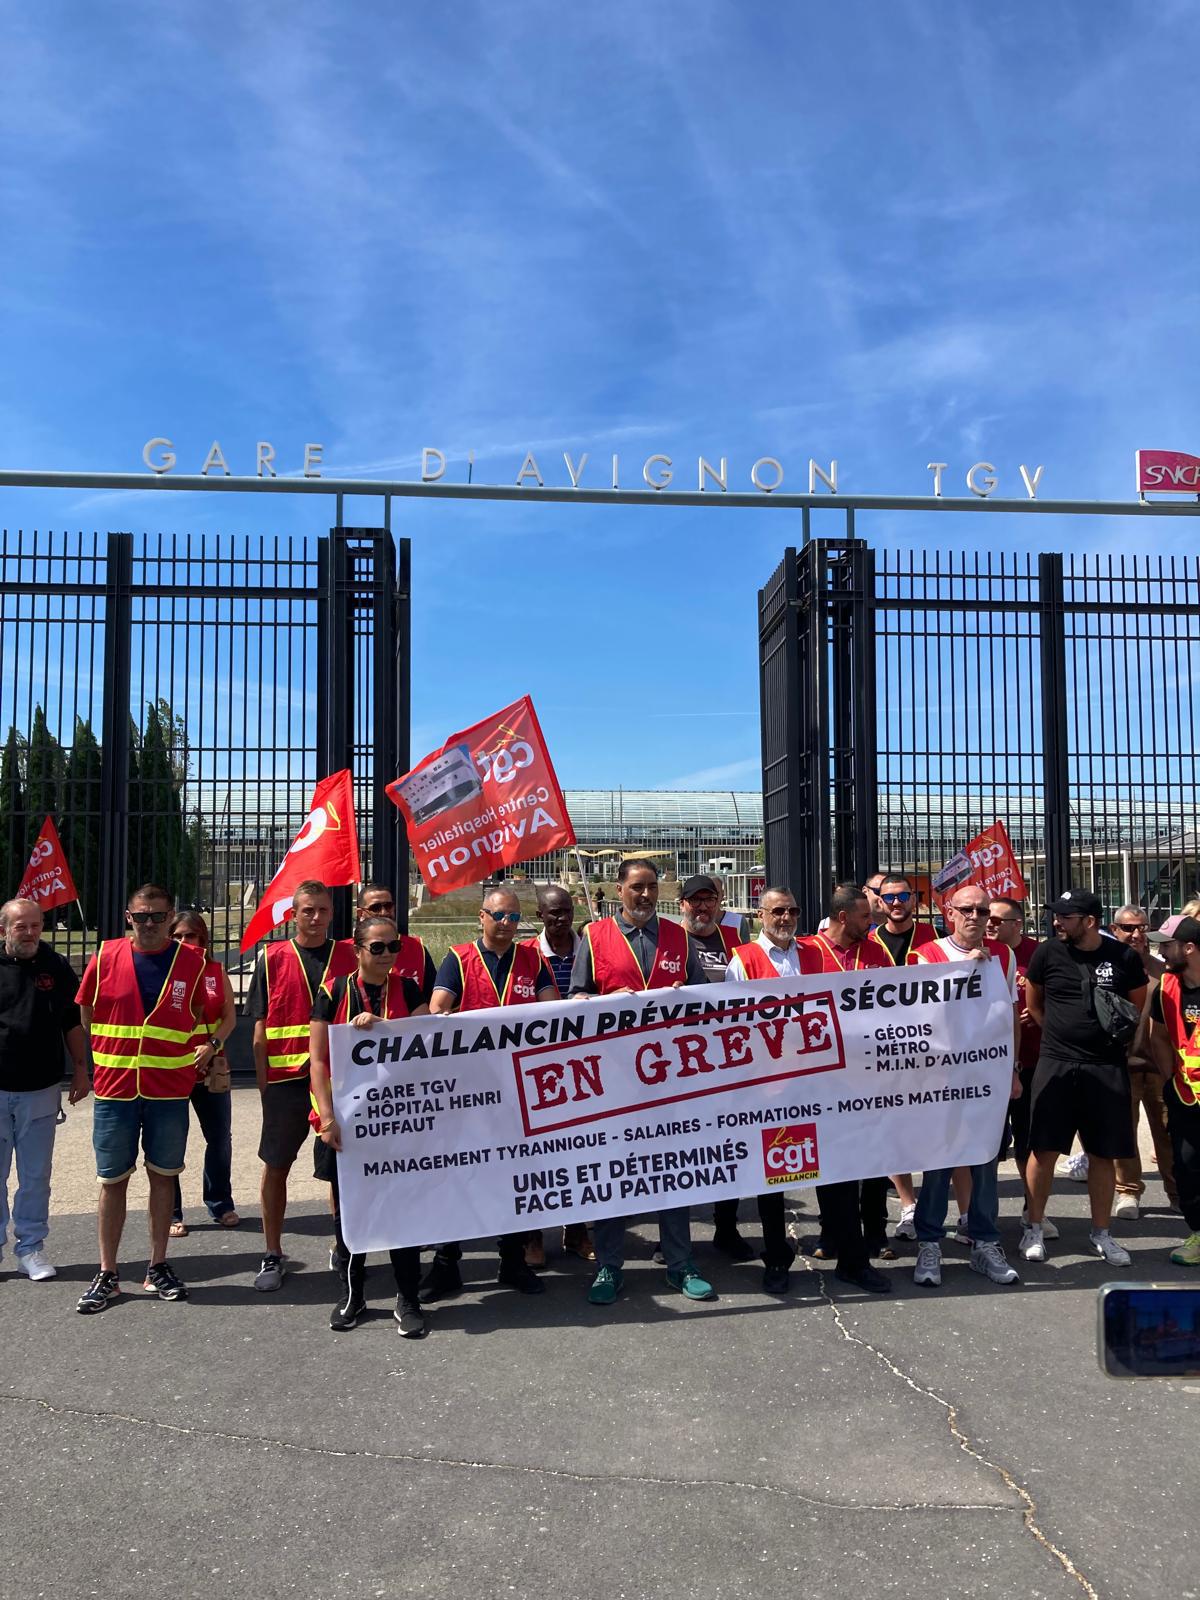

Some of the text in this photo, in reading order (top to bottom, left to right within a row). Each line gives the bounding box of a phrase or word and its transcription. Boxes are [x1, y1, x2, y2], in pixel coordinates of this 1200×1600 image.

[142, 437, 324, 478] GARE
[927, 462, 1044, 497] TGV
[753, 884, 765, 892] AV
[660, 959, 681, 974] cgt
[513, 984, 536, 998] cgt
[351, 1015, 586, 1066] CHALLANCIN
[596, 992, 805, 1037] PRÉVENTION
[840, 969, 983, 1011] SÉCURITÉ
[875, 1024, 933, 1043] GÉODIS
[876, 1038, 931, 1057] MÉTRO
[524, 1011, 833, 1111] EN GREVE
[876, 1056, 920, 1072] M.I.N.
[366, 1083, 415, 1104] GARE
[420, 1078, 457, 1095] TGV
[367, 1095, 444, 1119] HÔPITAL
[449, 1090, 502, 1110] HENRI
[355, 1116, 436, 1139] DUFFAUT
[364, 1149, 492, 1177] MANAGEMENT
[496, 1131, 607, 1161] TYRANNIQUE
[623, 1119, 702, 1142] SALAIRES
[717, 1103, 822, 1129] FORMATIONS
[838, 1094, 904, 1113] MOYENS
[908, 1084, 992, 1105] MATÉRIELS
[769, 1127, 804, 1148] la
[513, 1139, 749, 1194] UNIS ET DÉTERMINÉS
[767, 1137, 816, 1173] cgt
[515, 1164, 739, 1216] FACE AU PATRONAT
[767, 1171, 819, 1185] CHALLANCIN
